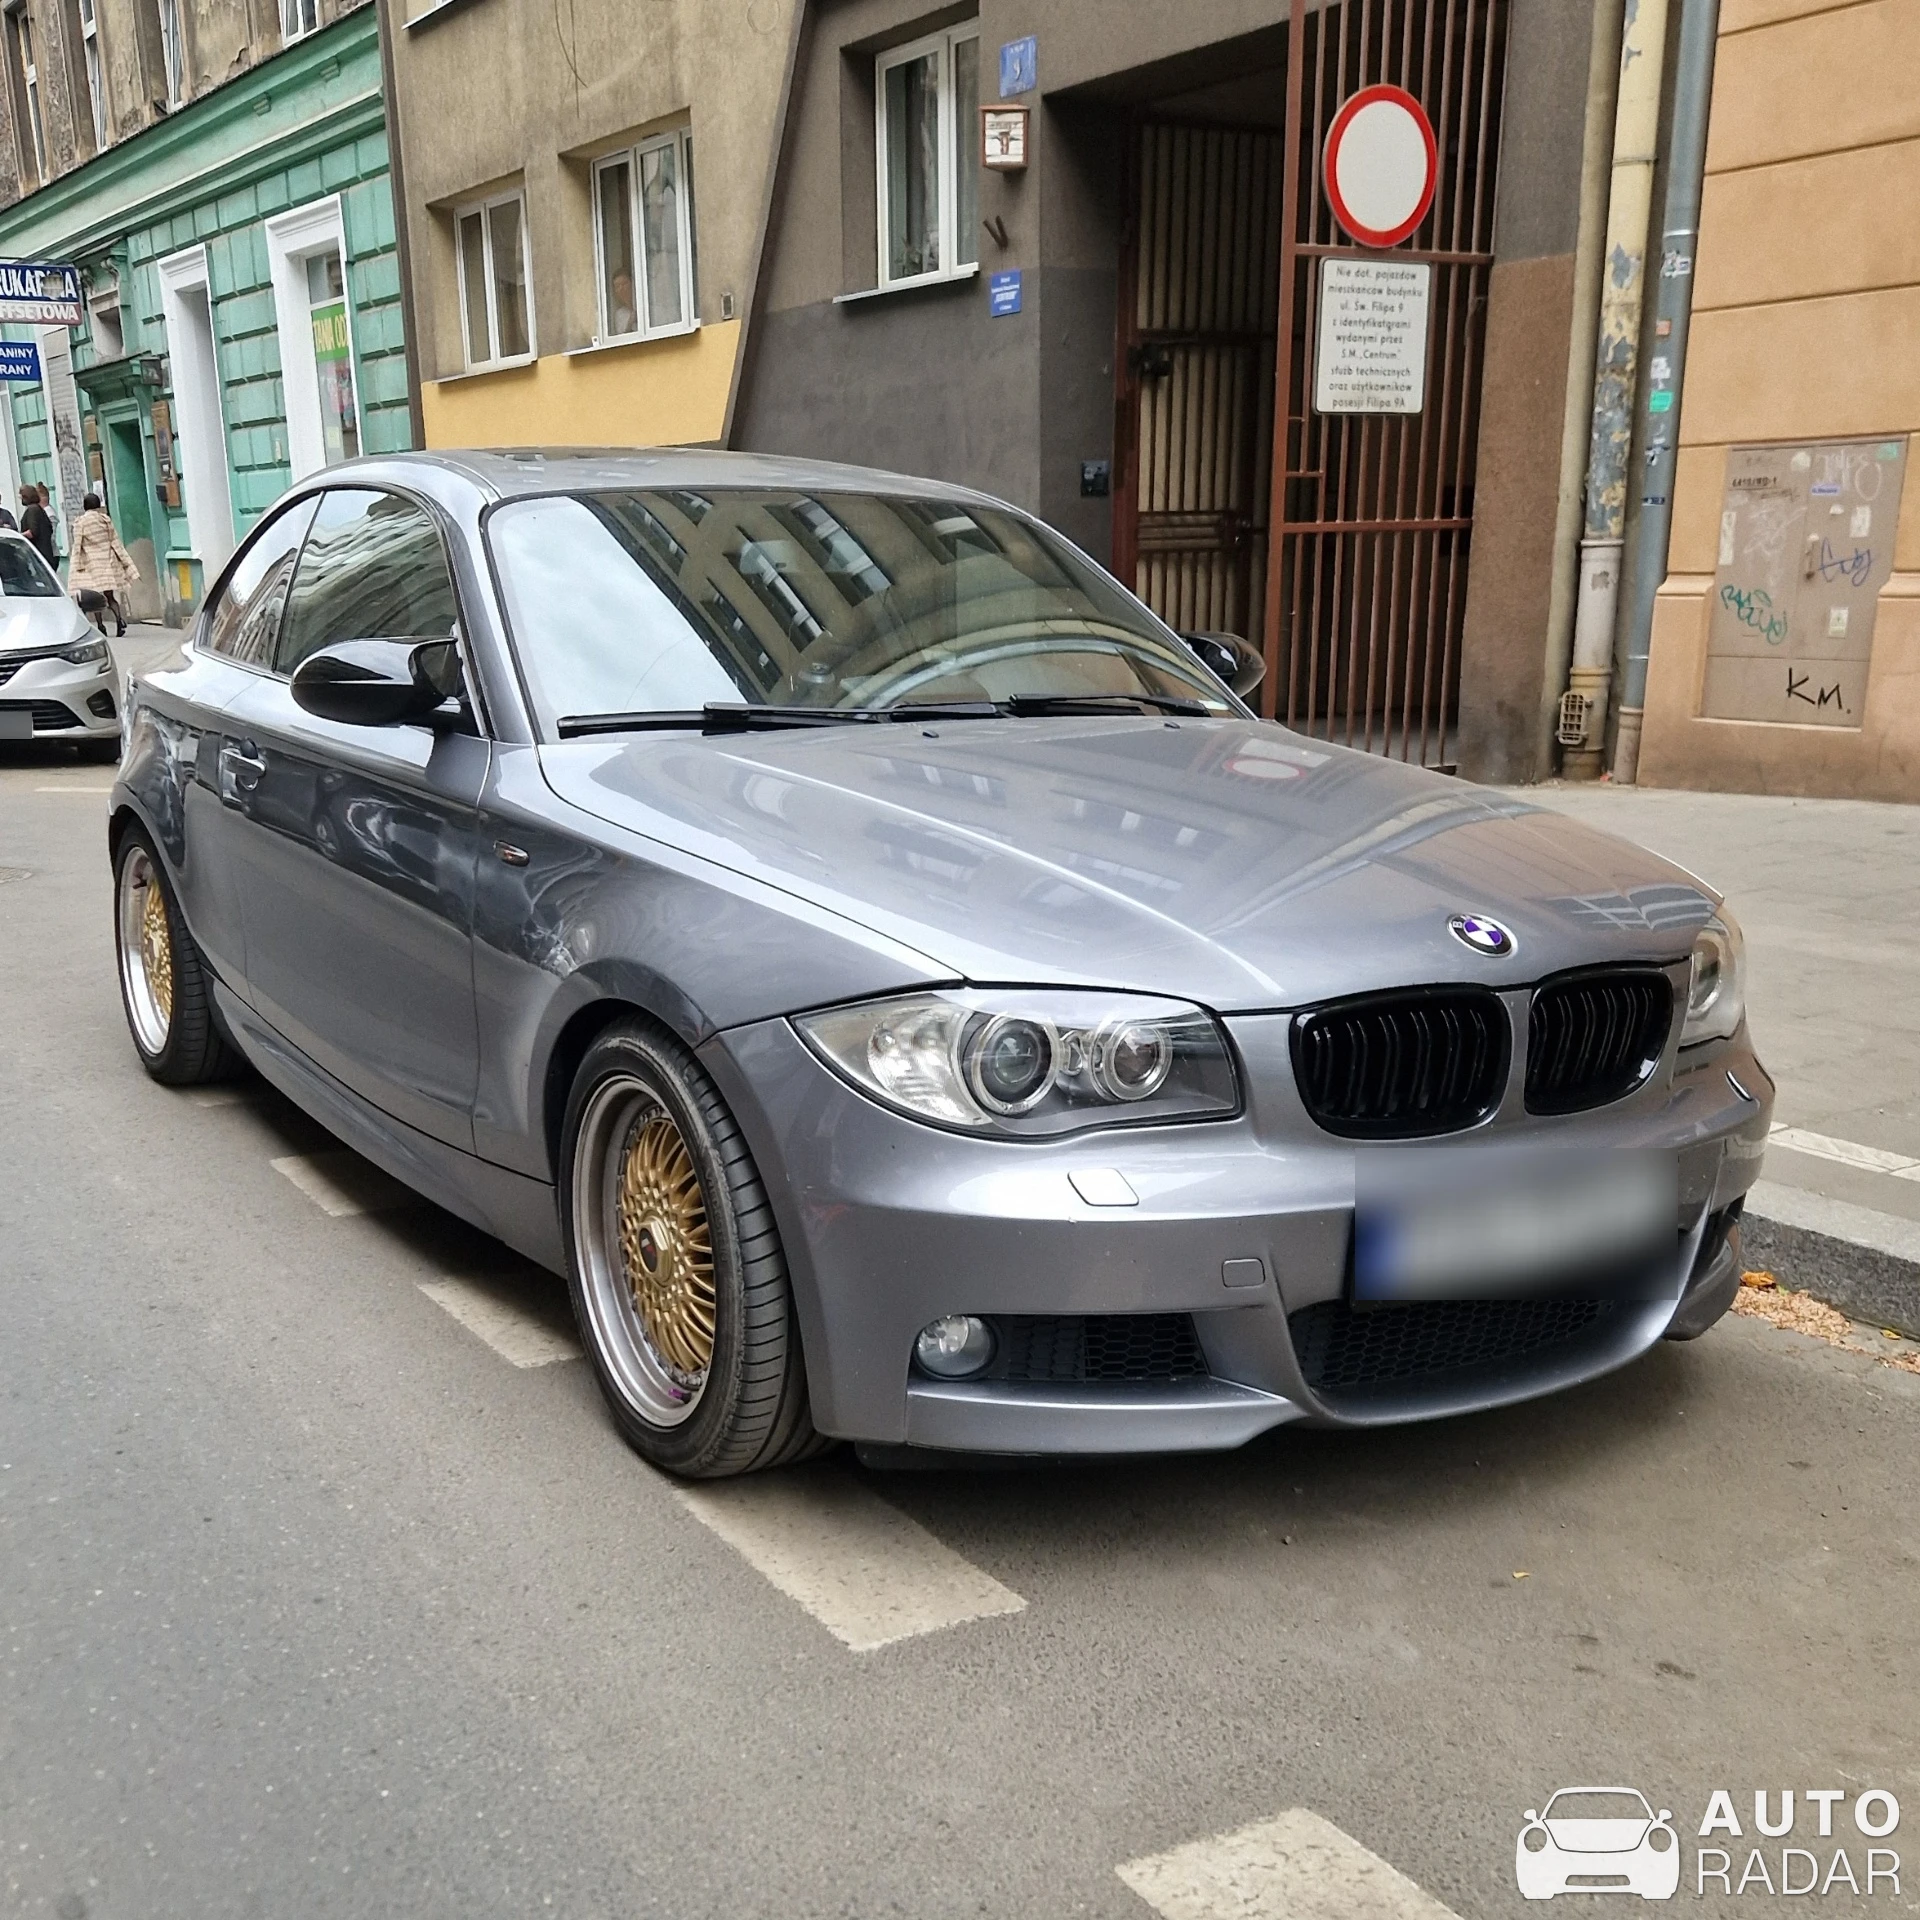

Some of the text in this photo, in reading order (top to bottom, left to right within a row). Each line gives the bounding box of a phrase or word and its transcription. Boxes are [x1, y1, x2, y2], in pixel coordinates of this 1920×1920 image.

[1336, 265, 1351, 276] Nie
[1386, 285, 1423, 299] budynku
[1372, 301, 1395, 314] Filipa
[1398, 302, 1404, 313] 9
[1332, 319, 1338, 327] z
[1336, 333, 1403, 346] wydanymi przez
[1356, 366, 1411, 378] technicznych
[1328, 383, 1348, 391] oraz
[1332, 396, 1406, 410] posesji Filipa 9A
